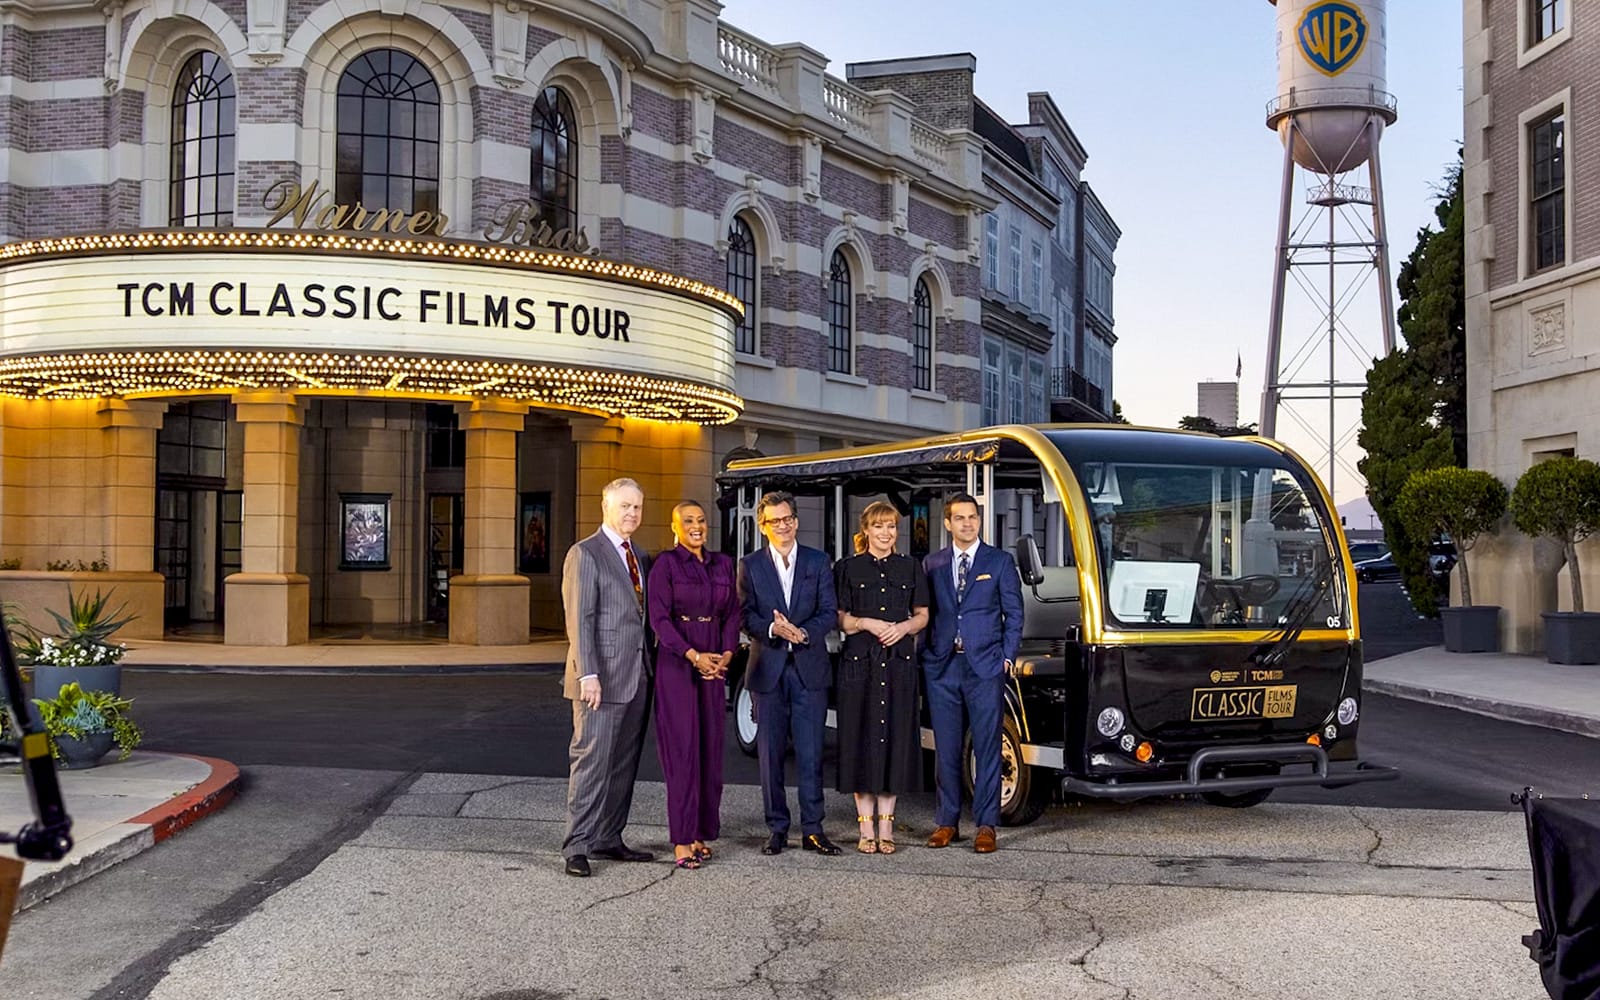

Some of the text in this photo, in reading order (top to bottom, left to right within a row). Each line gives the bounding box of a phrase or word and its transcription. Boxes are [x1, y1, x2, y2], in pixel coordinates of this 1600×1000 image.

[1303, 11, 1359, 64] WB
[262, 179, 599, 256] Warner Bros.
[117, 282, 631, 343] TCM CLASSIC FILMS TOUR
[1327, 615, 1341, 628] 05
[1251, 670, 1273, 681] TCM
[1198, 691, 1262, 717] CLASSIC
[1268, 689, 1293, 702] FILMS
[1267, 702, 1292, 714] TOUR
